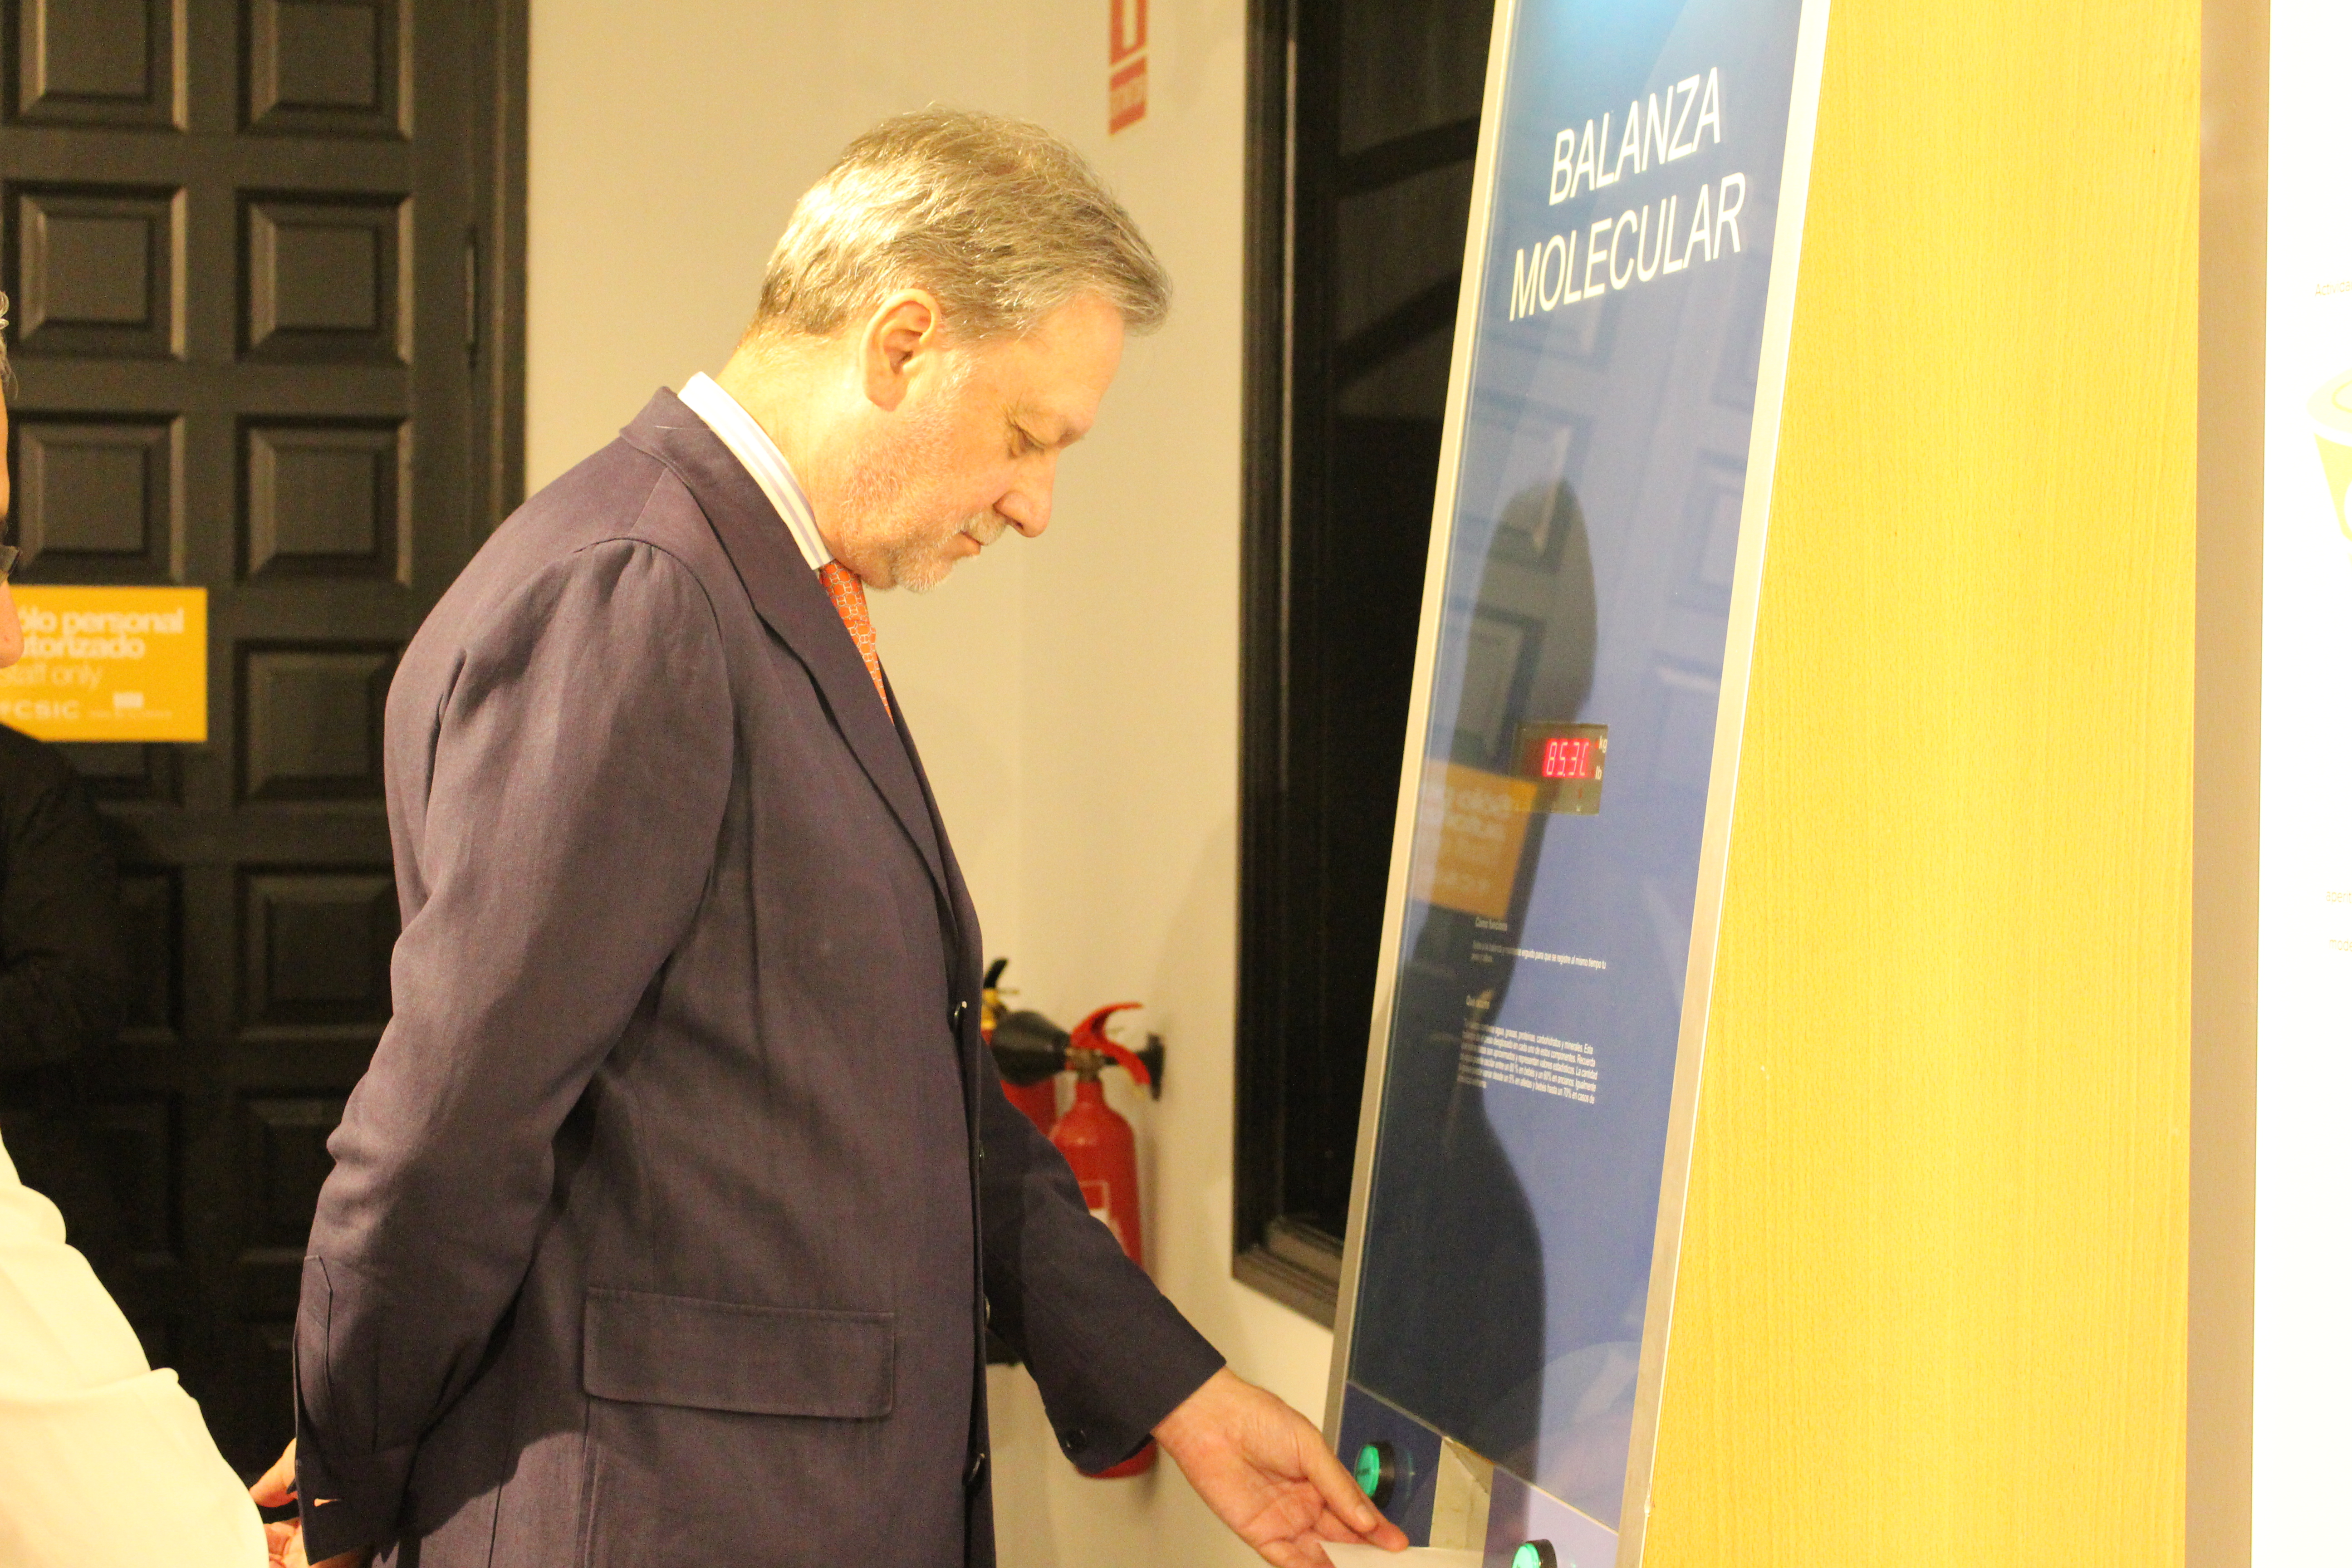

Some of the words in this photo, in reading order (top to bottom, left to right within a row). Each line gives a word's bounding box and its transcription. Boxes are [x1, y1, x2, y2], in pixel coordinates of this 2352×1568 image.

[1549, 66, 1720, 206] BALANZA
[1509, 172, 1746, 322] MOLECULAR
[2315, 279, 2352, 297] Activida
[62, 606, 185, 637] personal
[1599, 735, 1607, 753] kg
[1595, 765, 1602, 779] lb
[1575, 1067, 1581, 1076] La
